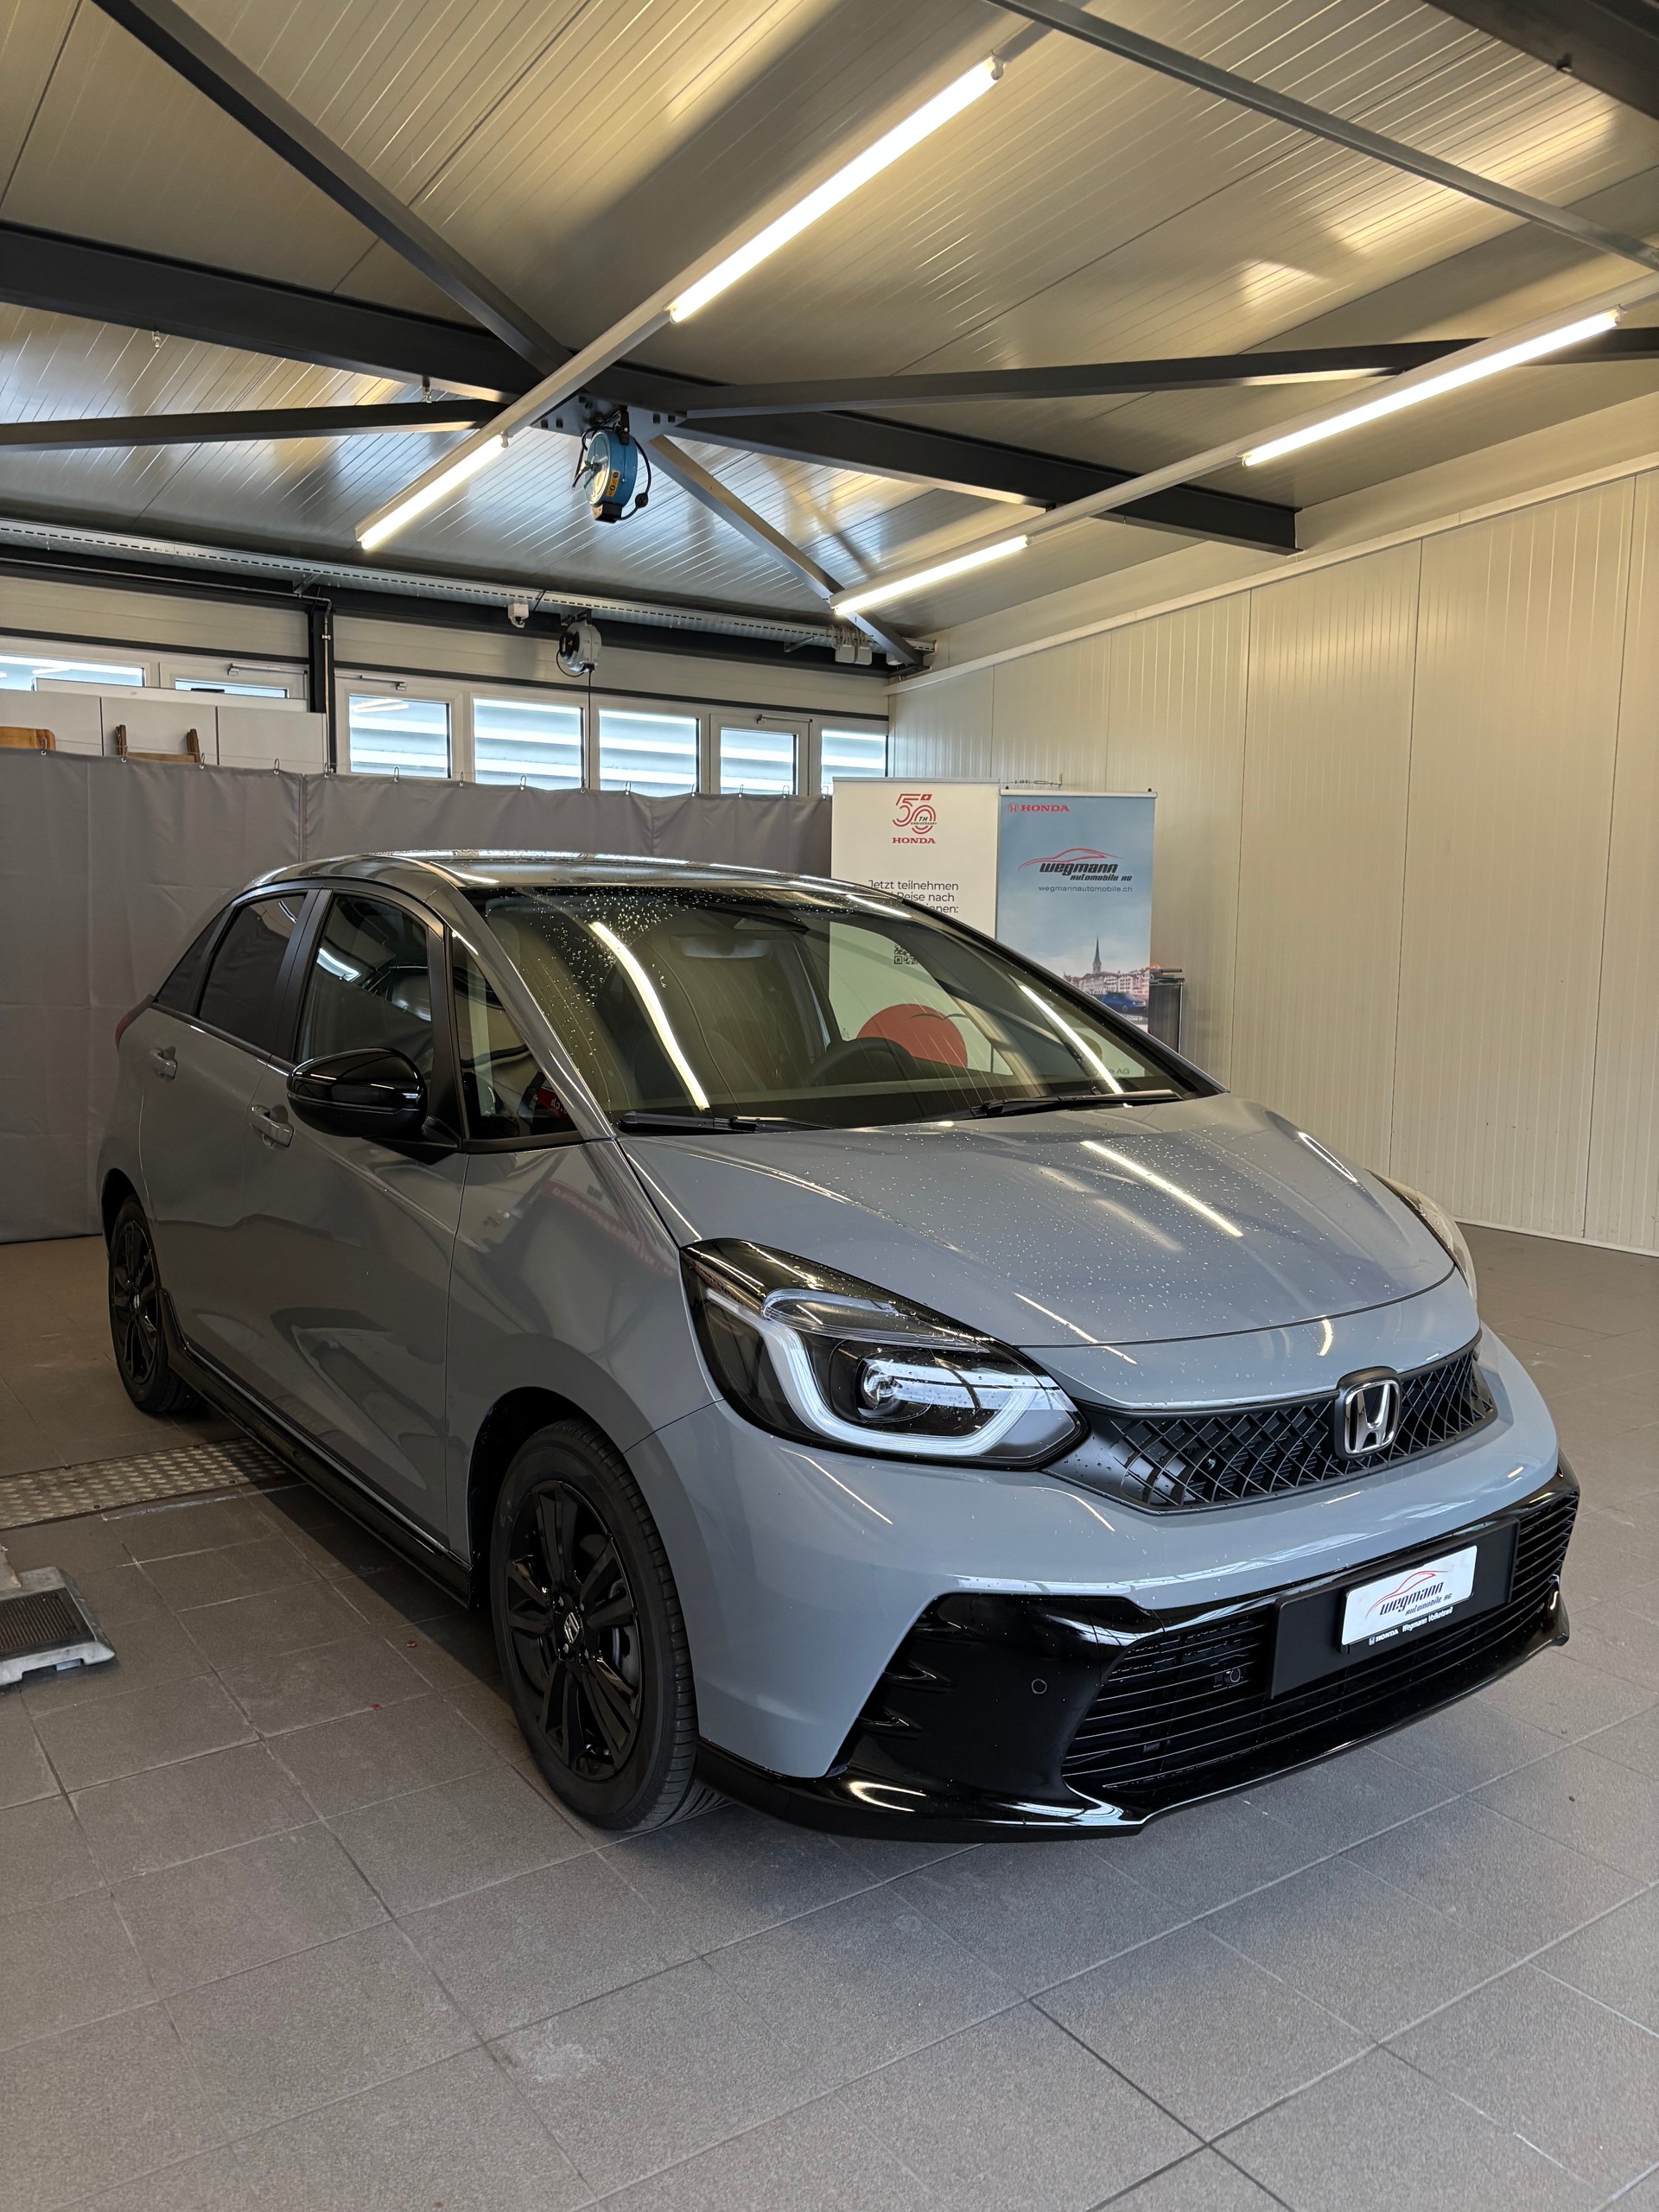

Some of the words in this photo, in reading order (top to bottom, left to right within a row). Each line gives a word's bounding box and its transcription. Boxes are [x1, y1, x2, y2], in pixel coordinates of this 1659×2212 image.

[1039, 863, 1118, 875] wegmann
[868, 880, 894, 890] Jetzt
[898, 880, 959, 891] teilnehmen
[929, 893, 955, 902] nach
[1380, 1582, 1444, 1615] wegmann
[1376, 1629, 1399, 1643] HONDA
